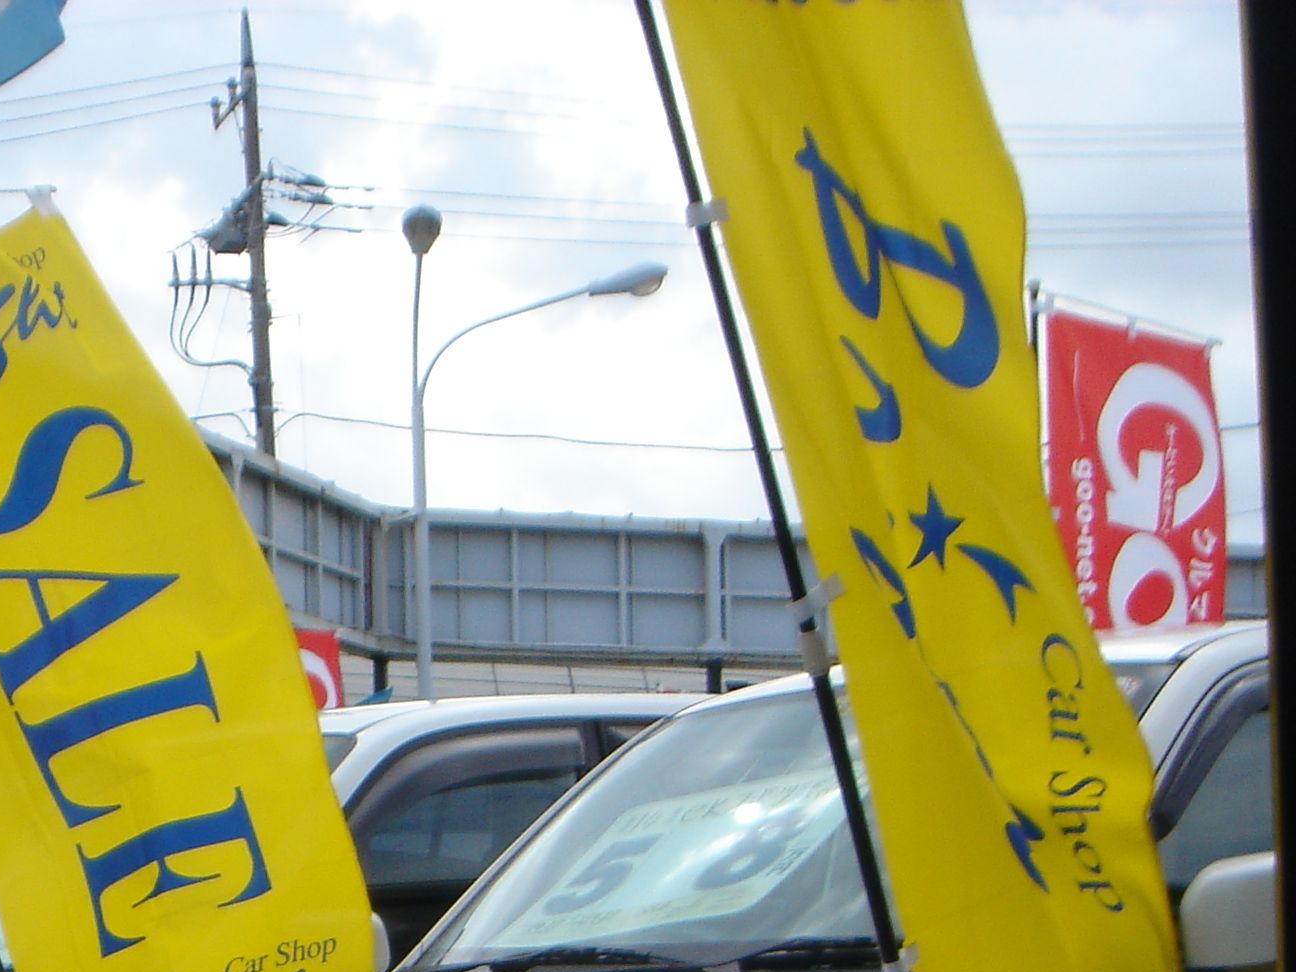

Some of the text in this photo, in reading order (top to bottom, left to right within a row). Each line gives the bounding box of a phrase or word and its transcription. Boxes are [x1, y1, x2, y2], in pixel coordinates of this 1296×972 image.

[1040, 632, 1124, 913] Car Shop
[275, 937, 337, 968] Shop
